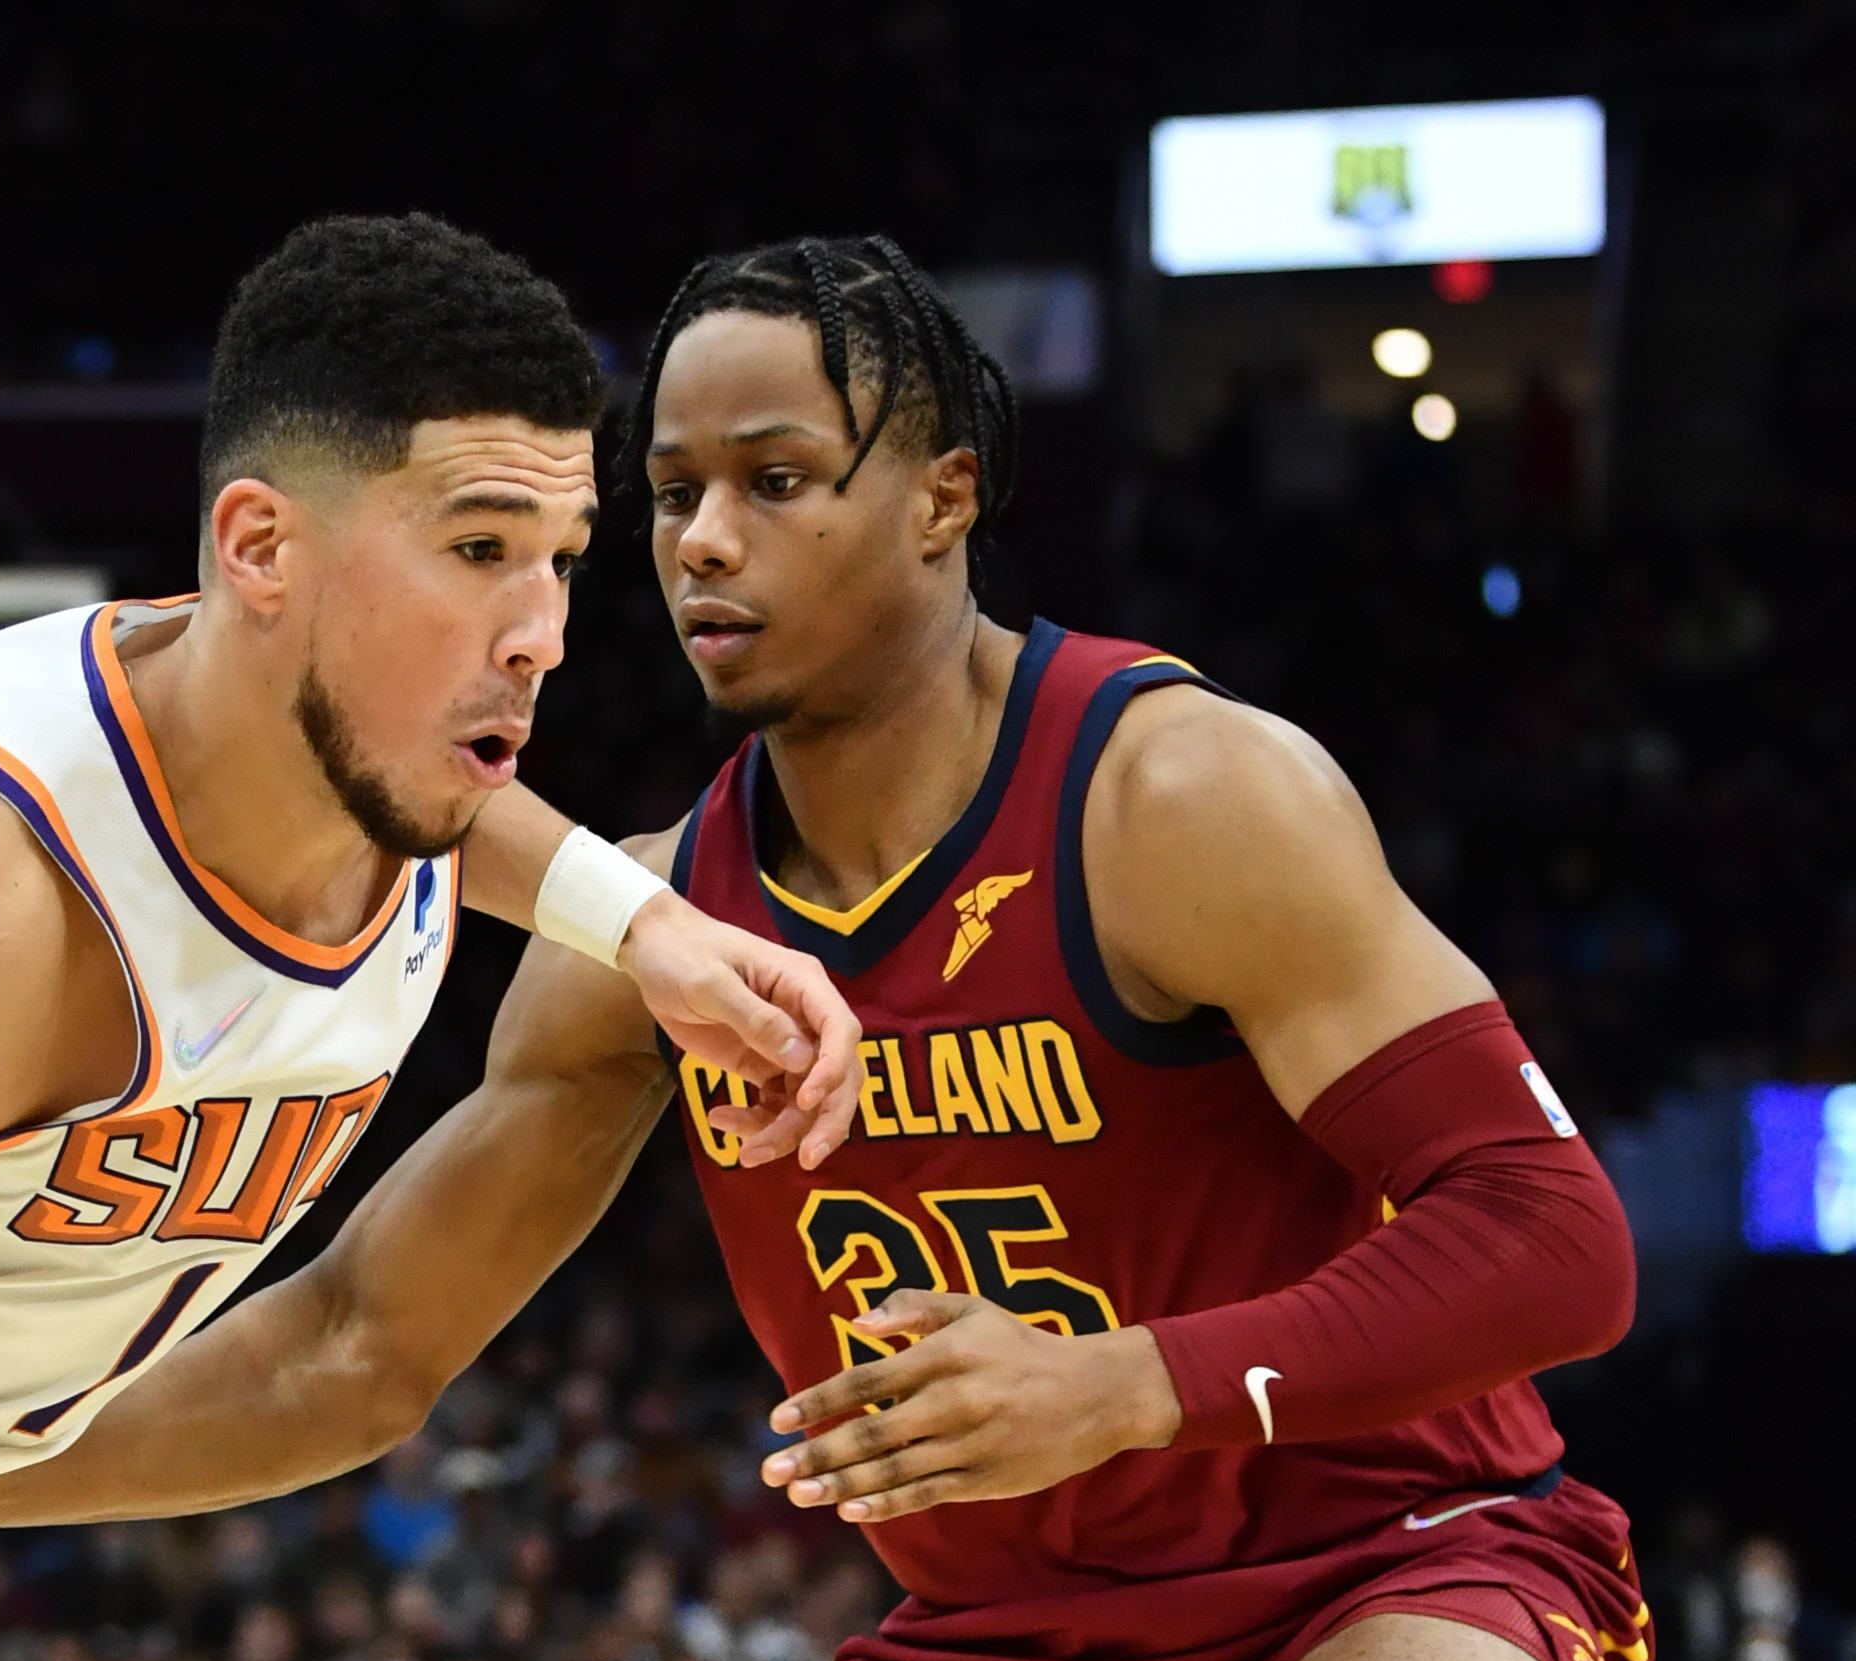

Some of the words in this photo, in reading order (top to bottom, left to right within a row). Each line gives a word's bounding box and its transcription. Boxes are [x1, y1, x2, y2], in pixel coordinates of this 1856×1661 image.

[404, 917, 445, 984] PayPal
[7, 1069, 393, 1245] SUN
[679, 1020, 1101, 1168] CELAND
[8, 1261, 225, 1438] 1
[797, 1184, 1119, 1414] 35
